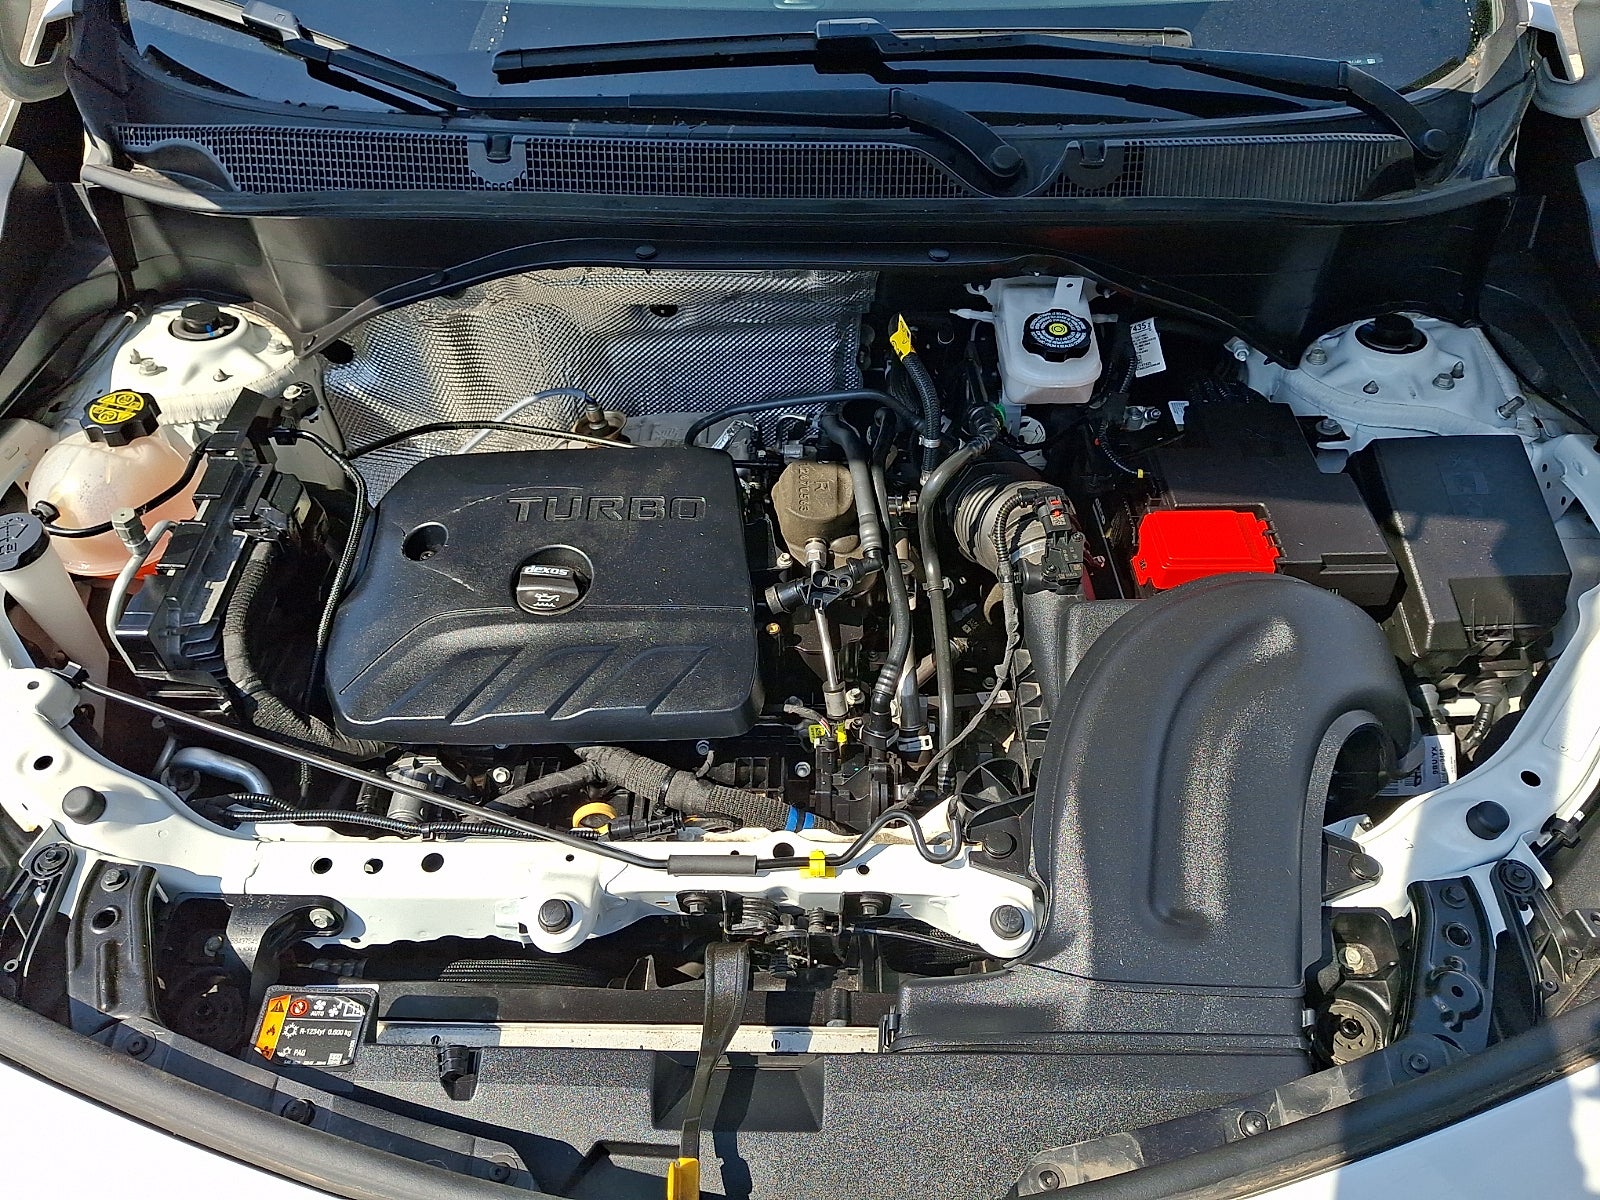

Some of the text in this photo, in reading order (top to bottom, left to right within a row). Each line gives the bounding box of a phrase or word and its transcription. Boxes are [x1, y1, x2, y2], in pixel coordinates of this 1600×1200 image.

[507, 496, 707, 522] TURBO
[524, 565, 570, 576] dexos
[299, 1028, 326, 1036] R-1234yf
[344, 1029, 352, 1037] kg
